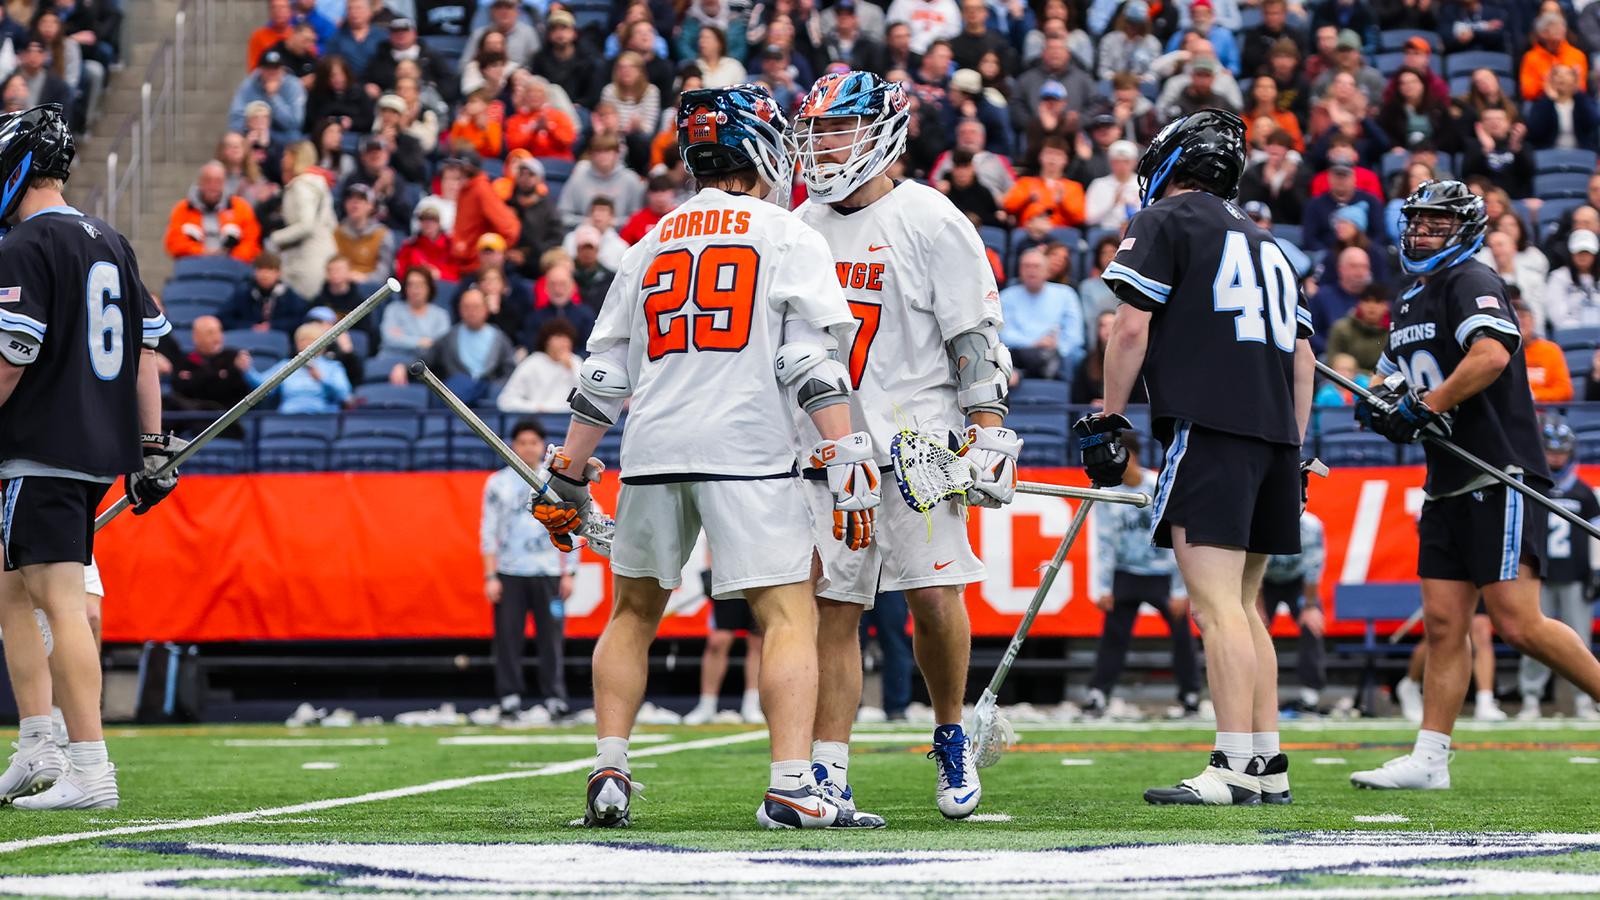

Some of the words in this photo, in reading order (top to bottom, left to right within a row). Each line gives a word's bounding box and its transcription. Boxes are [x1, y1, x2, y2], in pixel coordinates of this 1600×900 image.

[696, 114, 707, 124] 29
[659, 209, 752, 243] CORDES
[835, 261, 885, 291] NGE
[641, 244, 760, 362] 29
[1212, 230, 1298, 353] 40
[87, 261, 124, 380] 6
[8, 340, 33, 356] STX
[847, 300, 882, 390] 7
[1390, 322, 1436, 351] OPKINS
[854, 436, 863, 445] 29
[997, 430, 1008, 438] 77
[1003, 638, 1024, 667] STX
